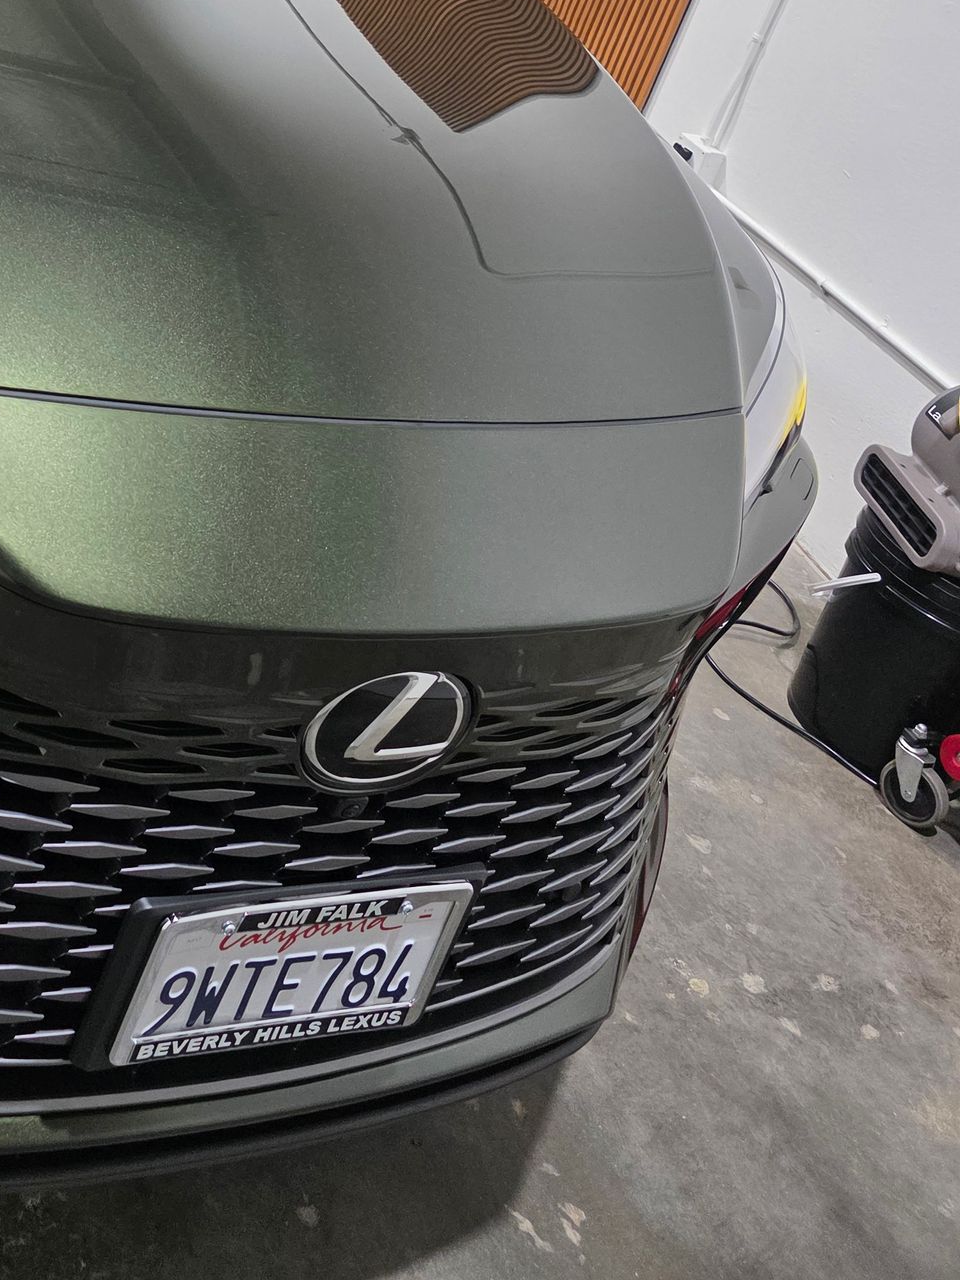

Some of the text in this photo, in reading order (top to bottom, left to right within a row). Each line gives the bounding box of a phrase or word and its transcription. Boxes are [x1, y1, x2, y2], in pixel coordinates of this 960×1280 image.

[218, 915, 402, 953] California
[257, 900, 389, 929] JIM FALK
[144, 943, 414, 1036] 9WTE784
[135, 1010, 402, 1060] BEVERLY HILLS LEXUS
